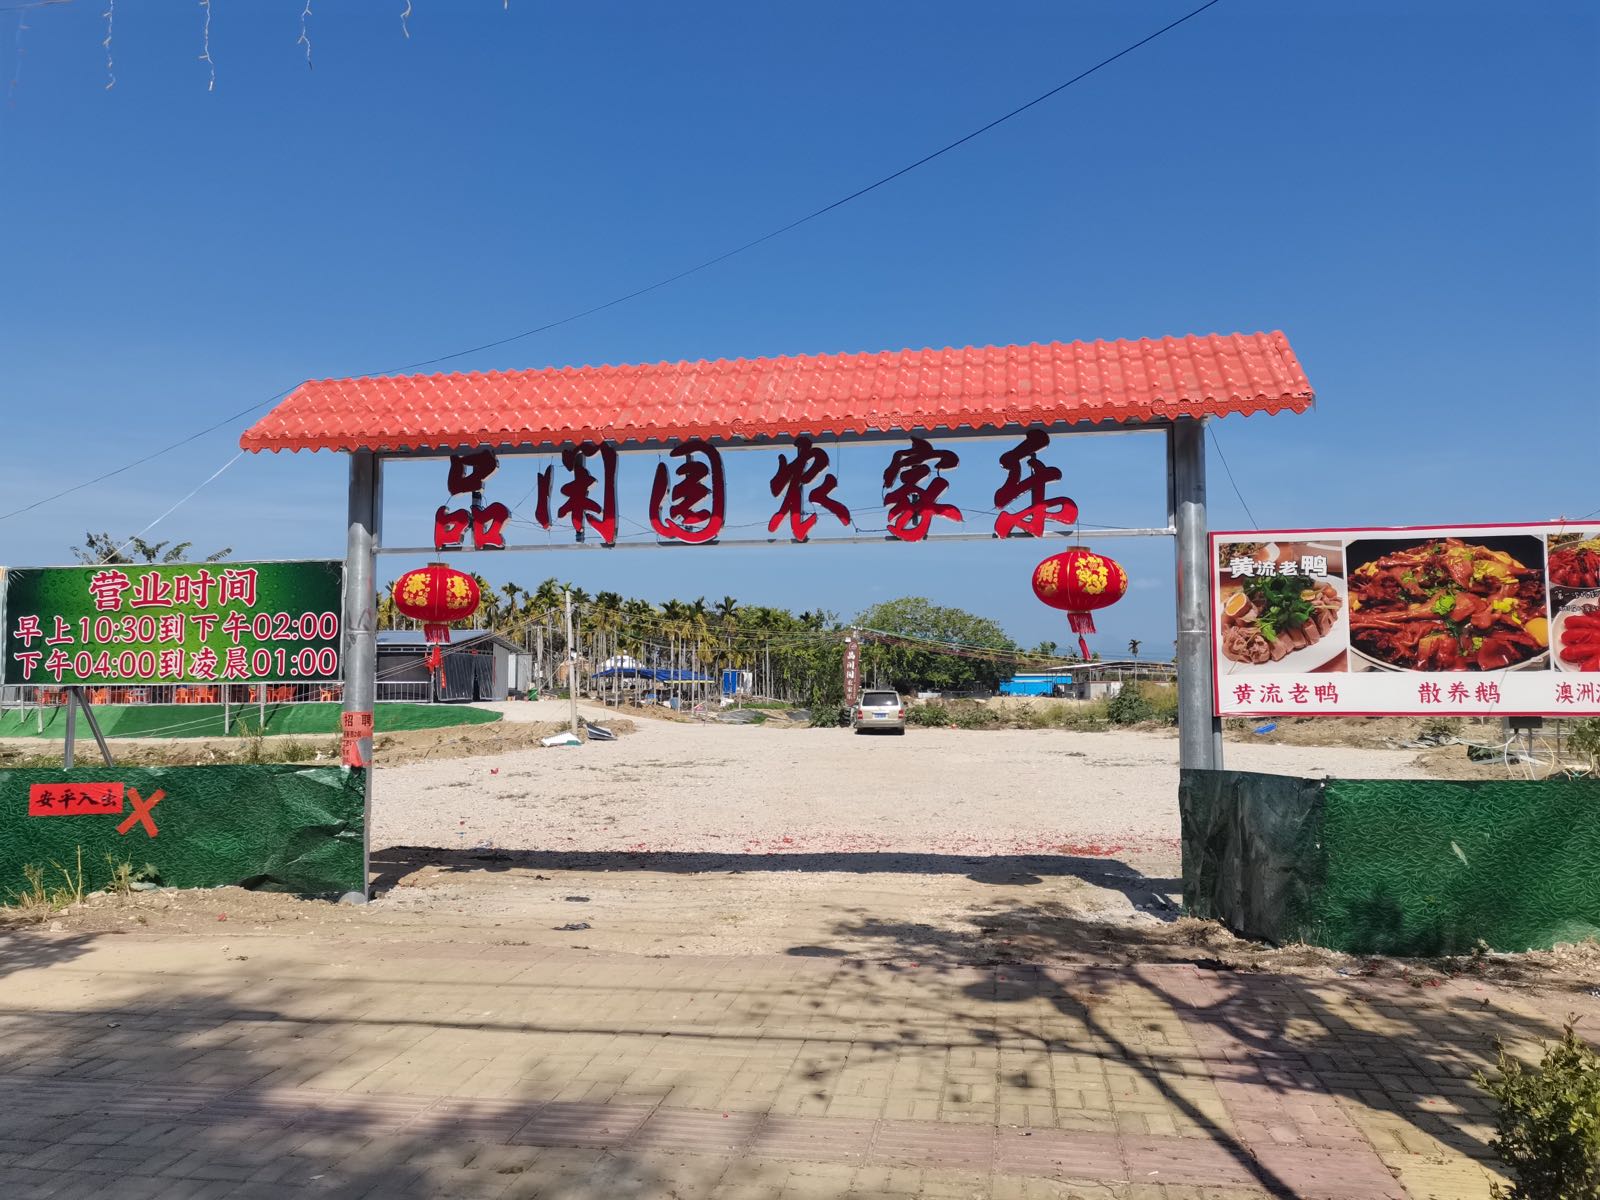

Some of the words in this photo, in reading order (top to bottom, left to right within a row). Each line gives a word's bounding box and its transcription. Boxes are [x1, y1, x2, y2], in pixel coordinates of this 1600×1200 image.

[1230, 555, 1328, 578] 黄流老鸭
[89, 568, 258, 612] 营业时间
[14, 611, 338, 648] 早上10:30到下午02:00
[14, 646, 338, 682] 下午04:00到凌晨01:00
[1232, 682, 1339, 705] 黄流老鸭
[1417, 681, 1501, 704] 散养鹅
[344, 714, 372, 727] 招聘
